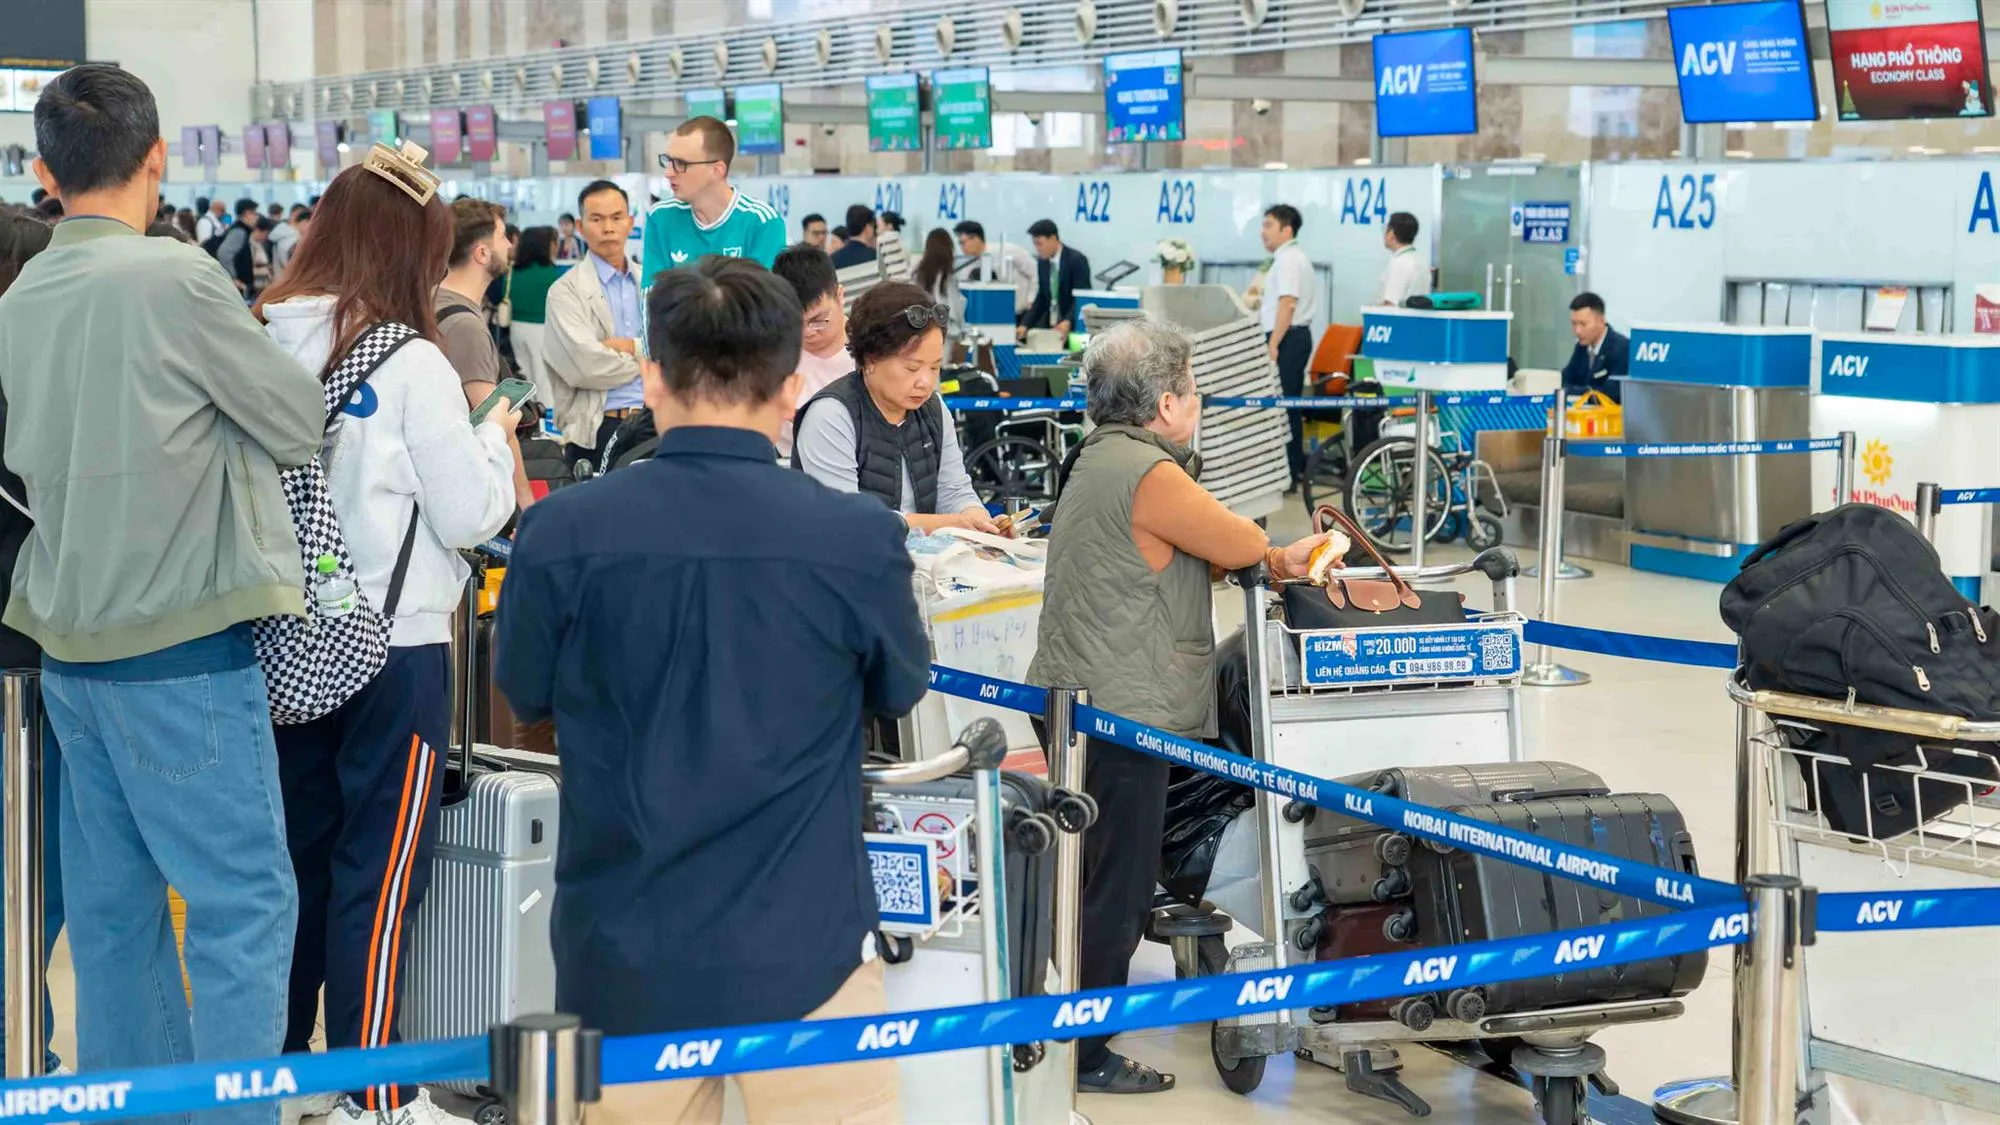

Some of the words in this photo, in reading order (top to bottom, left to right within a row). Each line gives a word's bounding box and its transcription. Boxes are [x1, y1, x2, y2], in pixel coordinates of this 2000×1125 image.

[1681, 41, 1737, 76] ACV
[1851, 52, 1886, 72] HẠNG
[1888, 43, 1914, 66] PHỔ
[1916, 45, 1962, 65] THÔNG
[1379, 63, 1423, 96] ACV
[1870, 69, 1914, 83] ECONOMY
[1915, 68, 1945, 81] CLASS
[875, 183, 903, 217] A20
[938, 183, 966, 220] A21
[1075, 181, 1110, 222] A22
[1157, 179, 1195, 223] A23
[1340, 177, 1387, 224] A24
[1652, 174, 1716, 229] A25
[1366, 325, 1392, 343] ACV
[1635, 341, 1670, 363] ACV
[1829, 355, 1869, 377] ACV
[1832, 487, 1861, 503] SN
[1957, 491, 1976, 501] ACV
[1376, 637, 1416, 655] 20.000
[1315, 665, 1332, 677] LIÊN
[1333, 665, 1343, 677] HỆ
[1344, 664, 1369, 676] QUẢNG
[980, 683, 999, 699] ACV
[1095, 717, 1116, 736] N.I.A
[1136, 728, 1163, 753] CẢNG
[1163, 740, 1191, 762] HÀNG
[1193, 751, 1229, 774] KHÔNG
[1230, 761, 1260, 784] QUỐC
[1262, 769, 1279, 788] TẾ
[1277, 774, 1297, 797] NỘI
[1344, 793, 1373, 816] N.I.A
[1403, 809, 1447, 837] NOIBAI
[1449, 821, 1553, 868] INTERNATIONAL
[1556, 851, 1620, 885] AIRPORT
[1655, 877, 1694, 904] N.I.A
[1856, 900, 1902, 924] ACV
[656, 1038, 721, 1071] ACV
[857, 1019, 919, 1051] ACV
[1054, 997, 1112, 1028] ACV
[1237, 976, 1294, 1005] ACV
[1404, 955, 1458, 985] ACV
[1554, 934, 1605, 964] ACV
[215, 1067, 298, 1101] N.I.A
